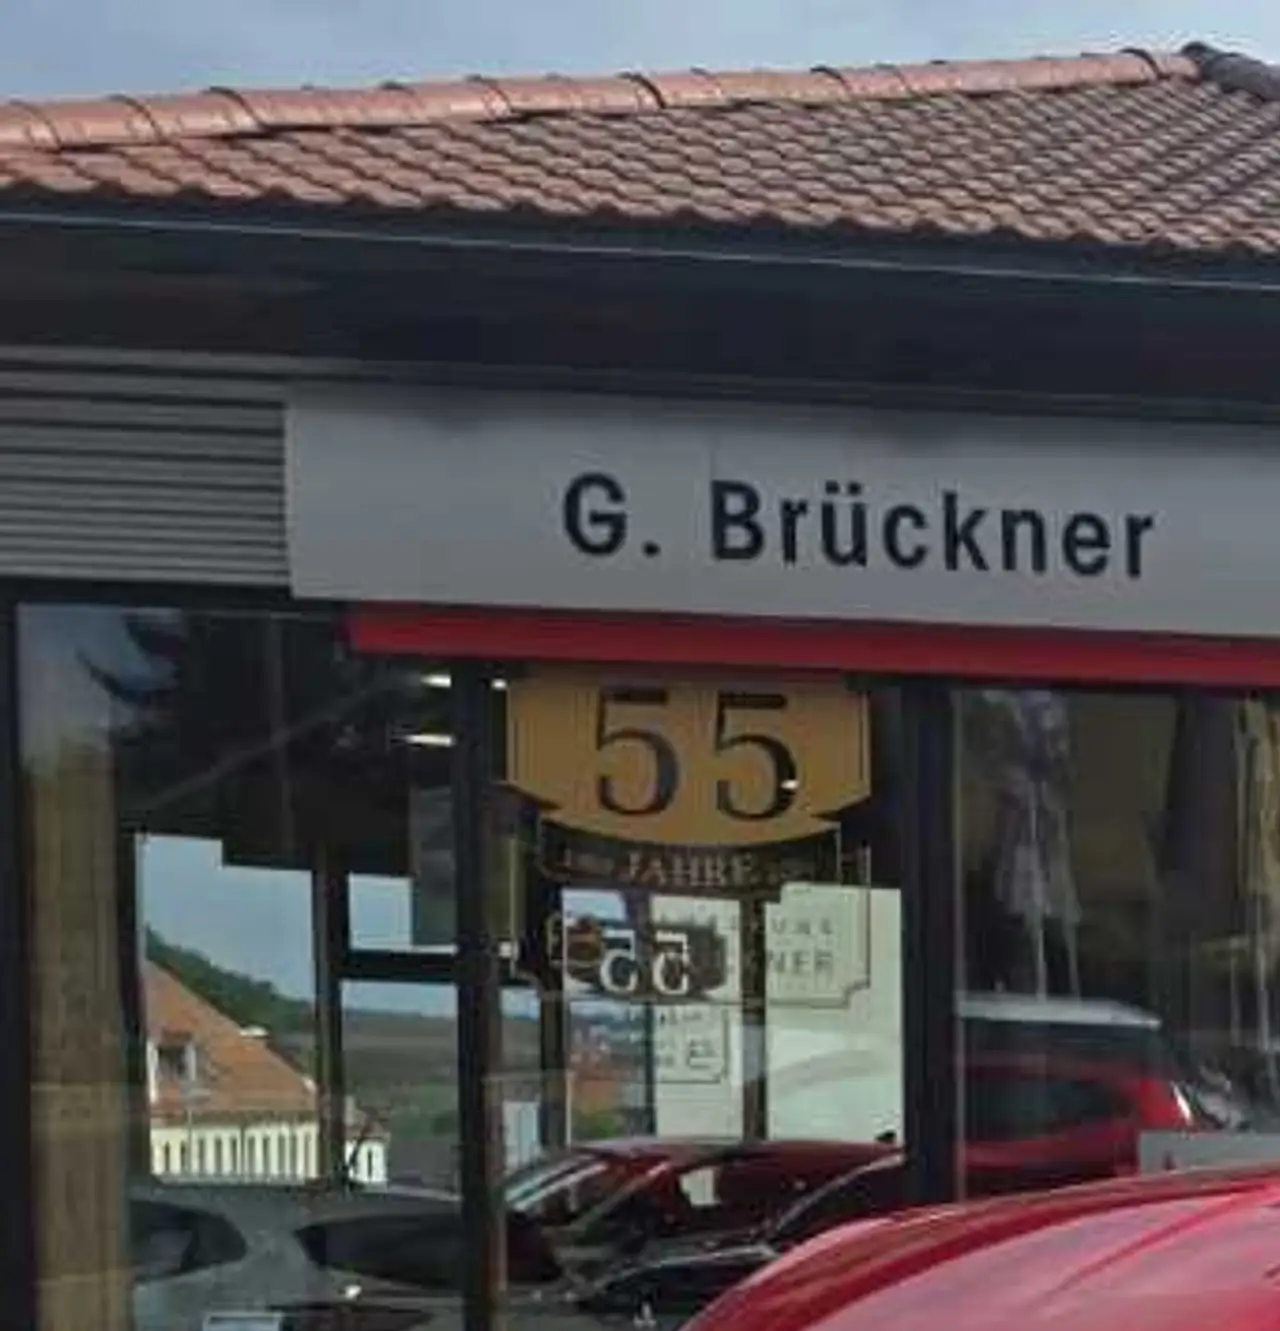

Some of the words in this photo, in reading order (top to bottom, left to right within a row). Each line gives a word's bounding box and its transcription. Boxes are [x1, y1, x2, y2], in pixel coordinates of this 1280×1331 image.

[563, 472, 661, 557] G.
[711, 480, 1154, 579] Brückner
[597, 688, 798, 820] 55
